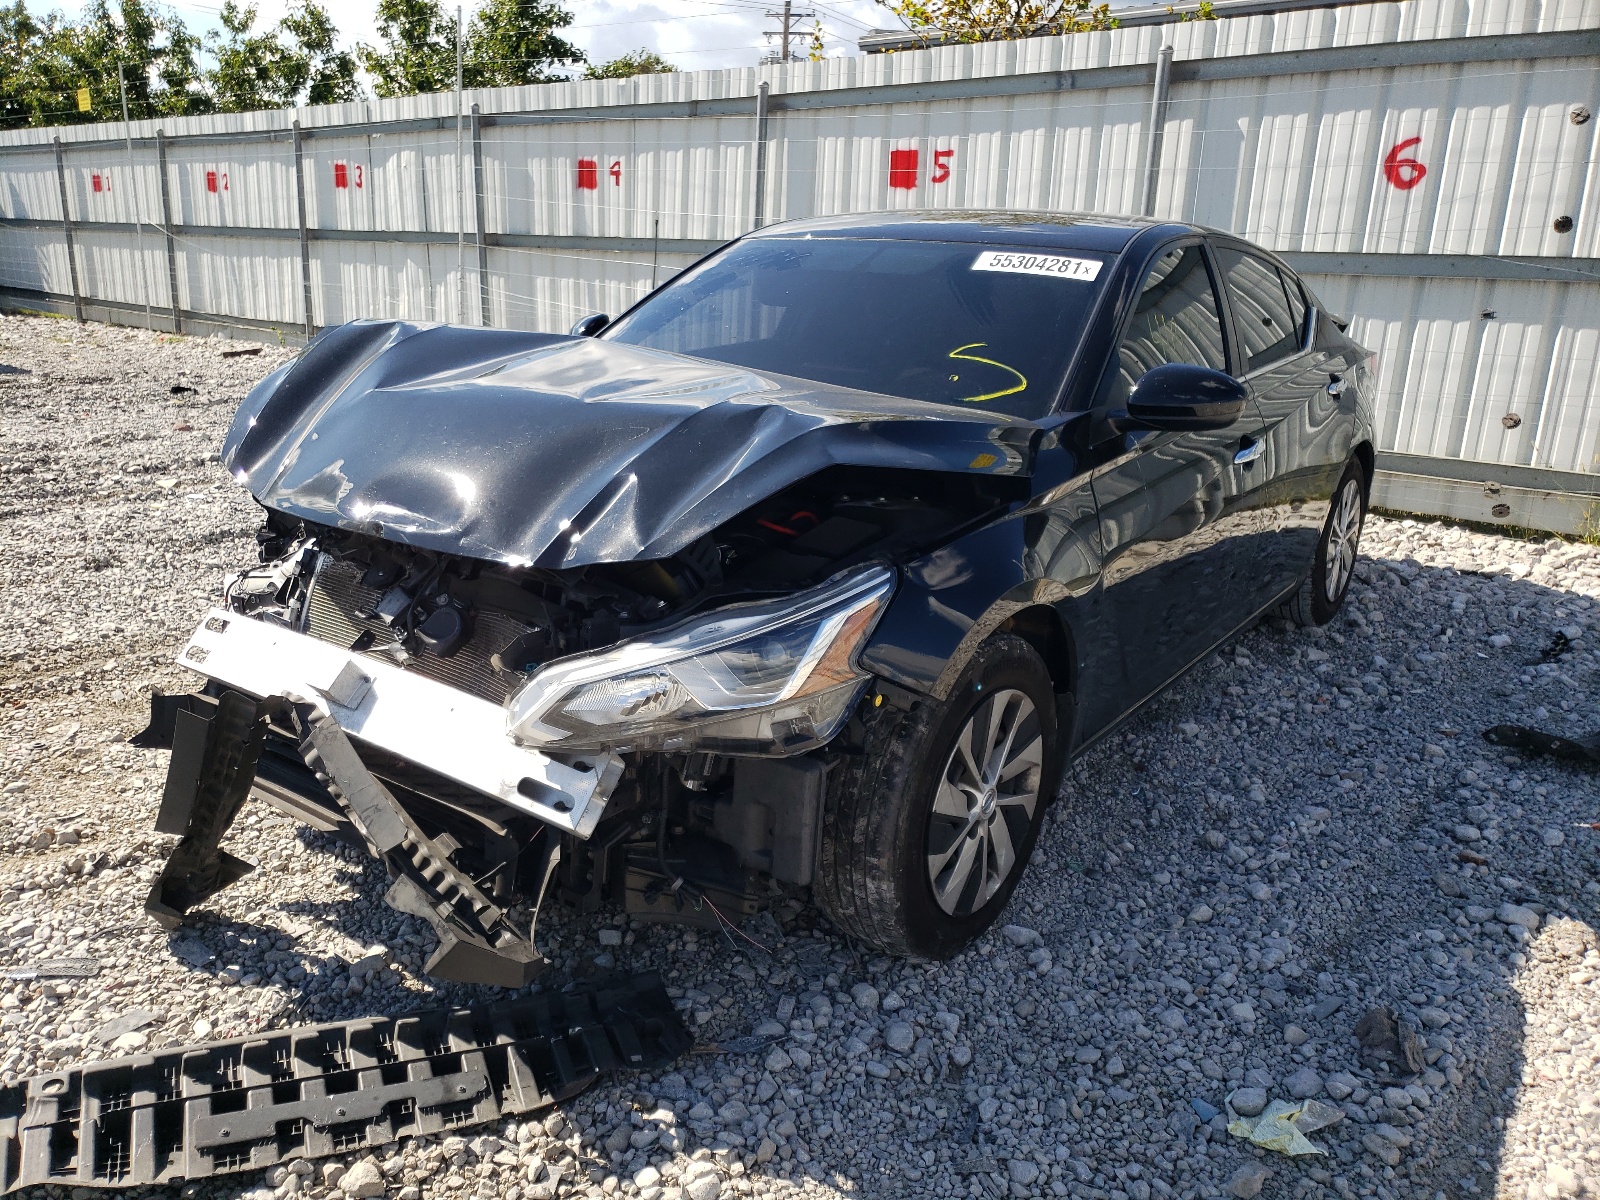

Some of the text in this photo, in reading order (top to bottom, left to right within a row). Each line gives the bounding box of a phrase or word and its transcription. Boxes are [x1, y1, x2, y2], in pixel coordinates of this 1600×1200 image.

[609, 161, 622, 187] 4
[931, 149, 955, 185] 5
[1383, 137, 1428, 191] 6
[106, 175, 111, 192] 1
[221, 173, 229, 191] 2
[355, 165, 363, 189] 3
